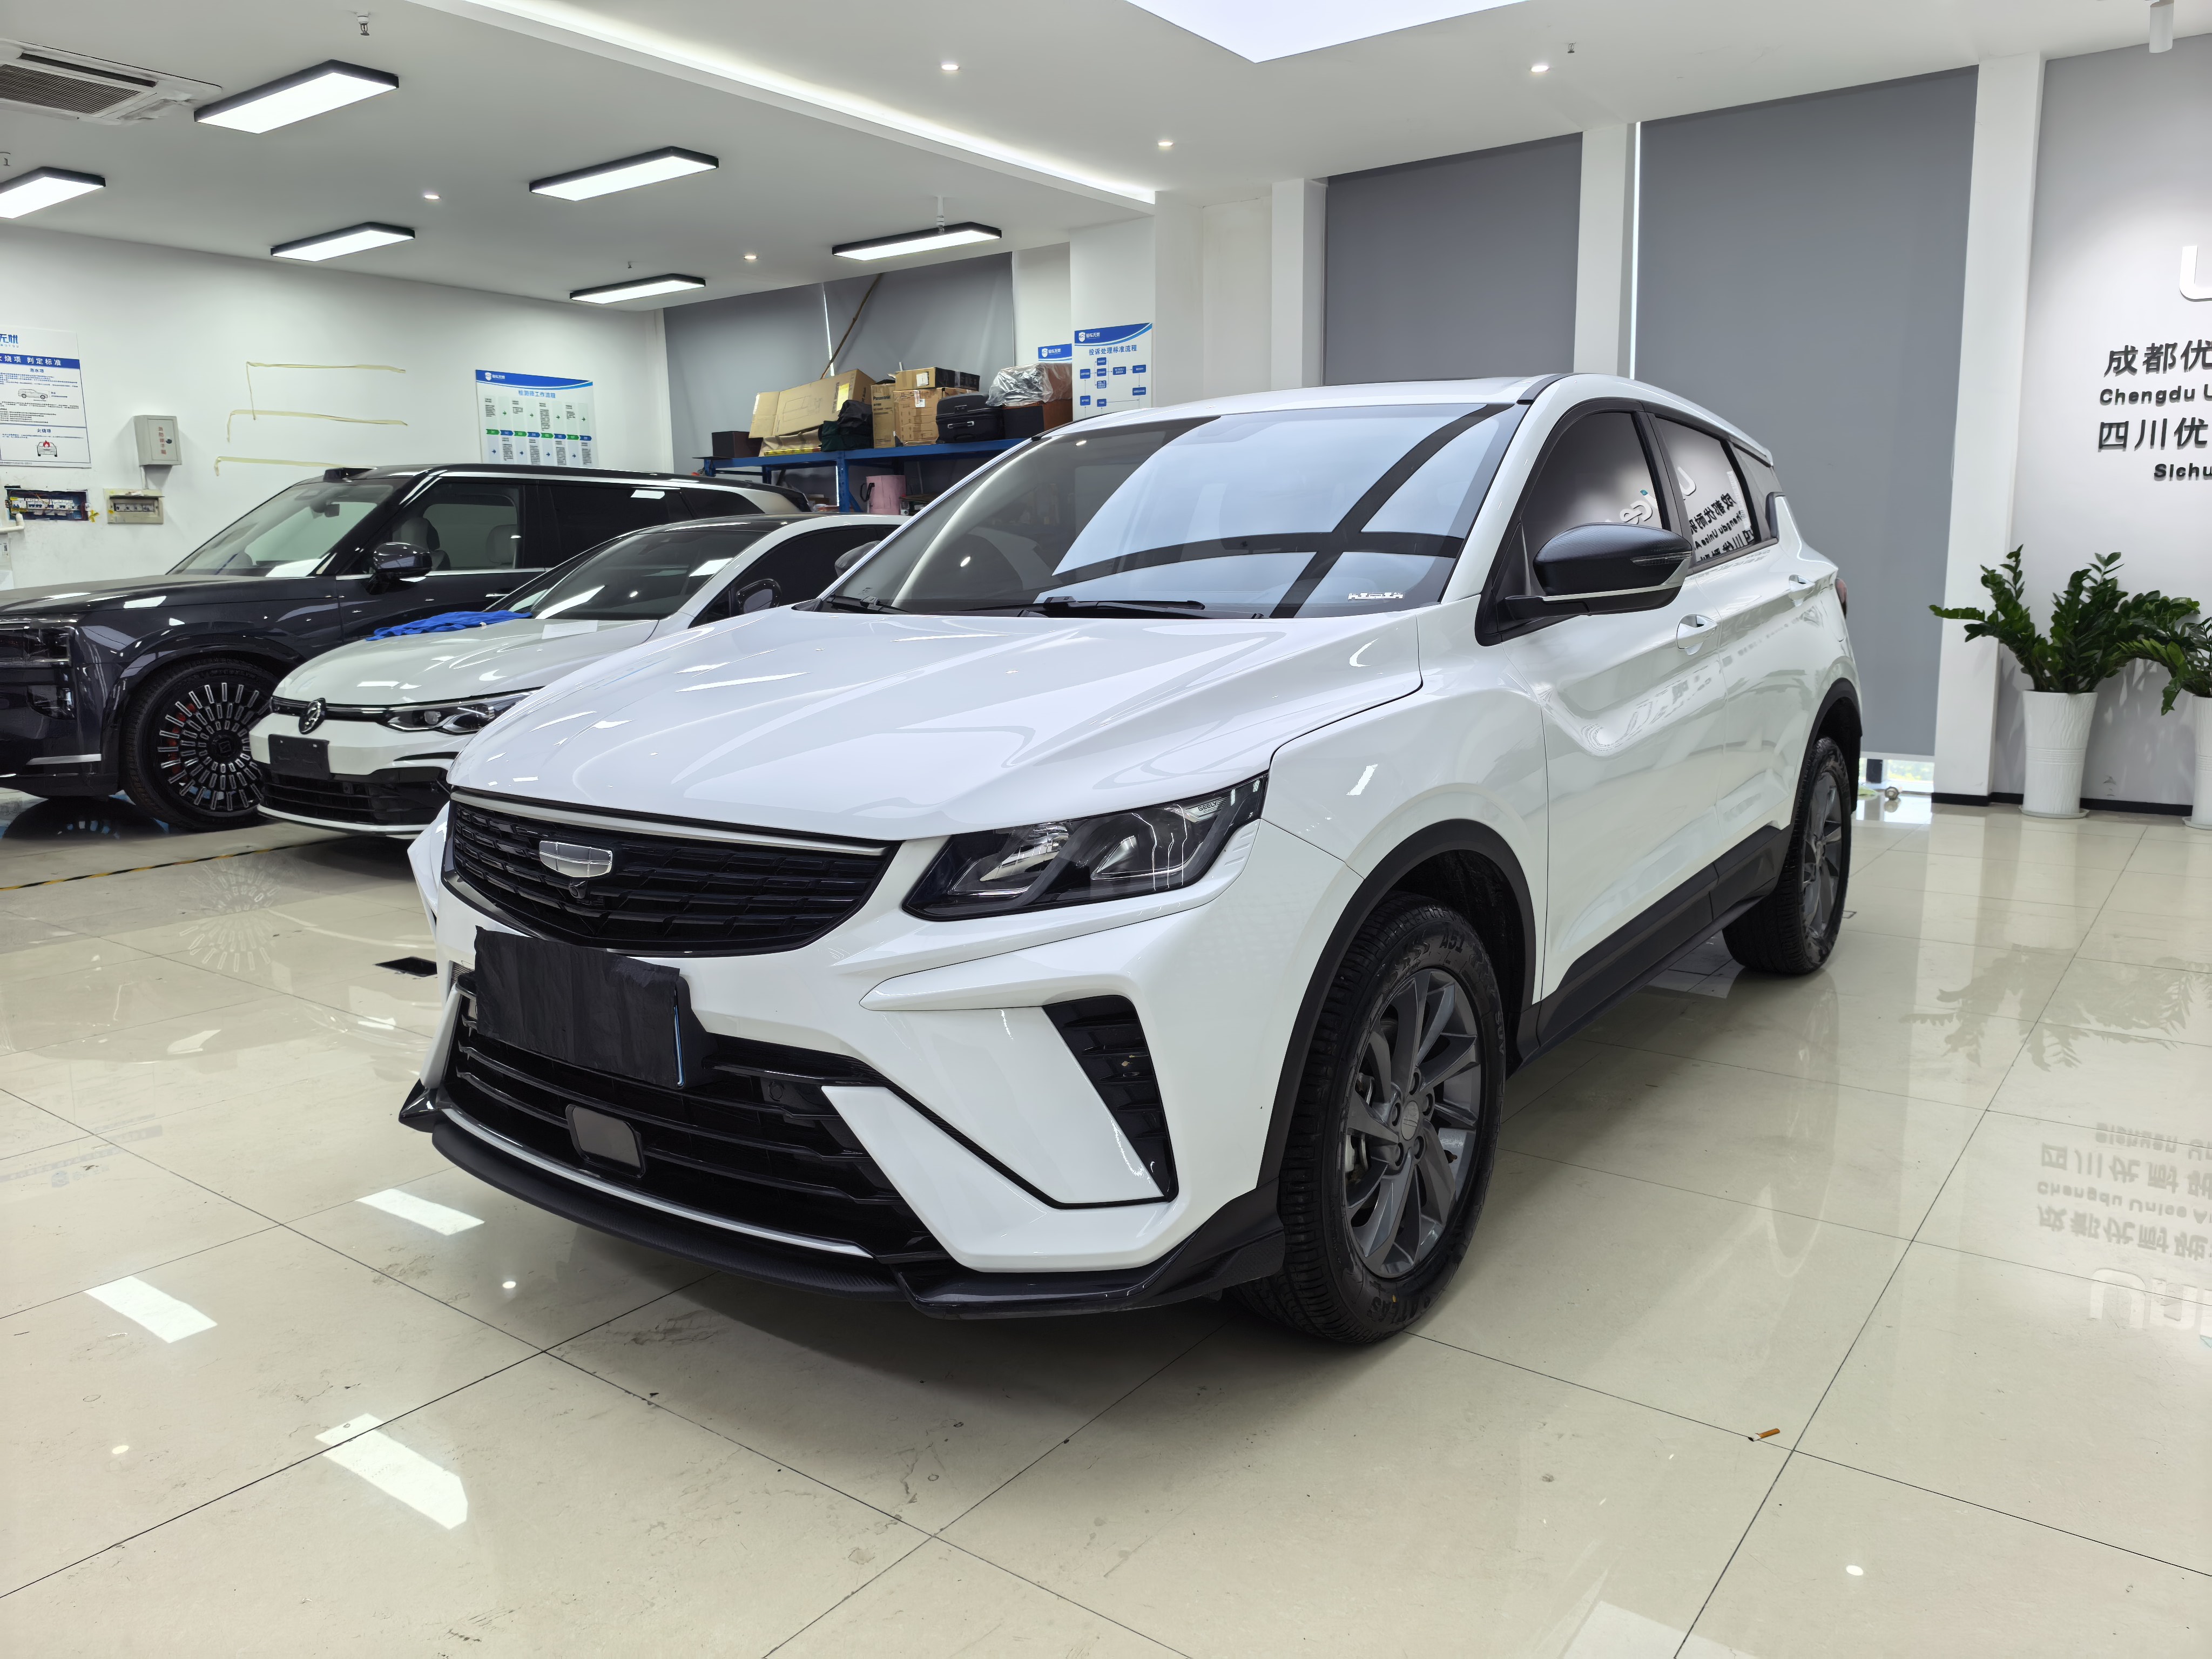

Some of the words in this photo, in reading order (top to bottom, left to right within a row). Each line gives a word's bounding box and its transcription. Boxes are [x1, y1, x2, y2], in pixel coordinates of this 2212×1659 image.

[1089, 345, 1137, 356] 投诉处理标准流程
[26, 357, 62, 366] 判定标准
[2099, 385, 2196, 406] Chengdu
[2098, 417, 2209, 453] 四川优
